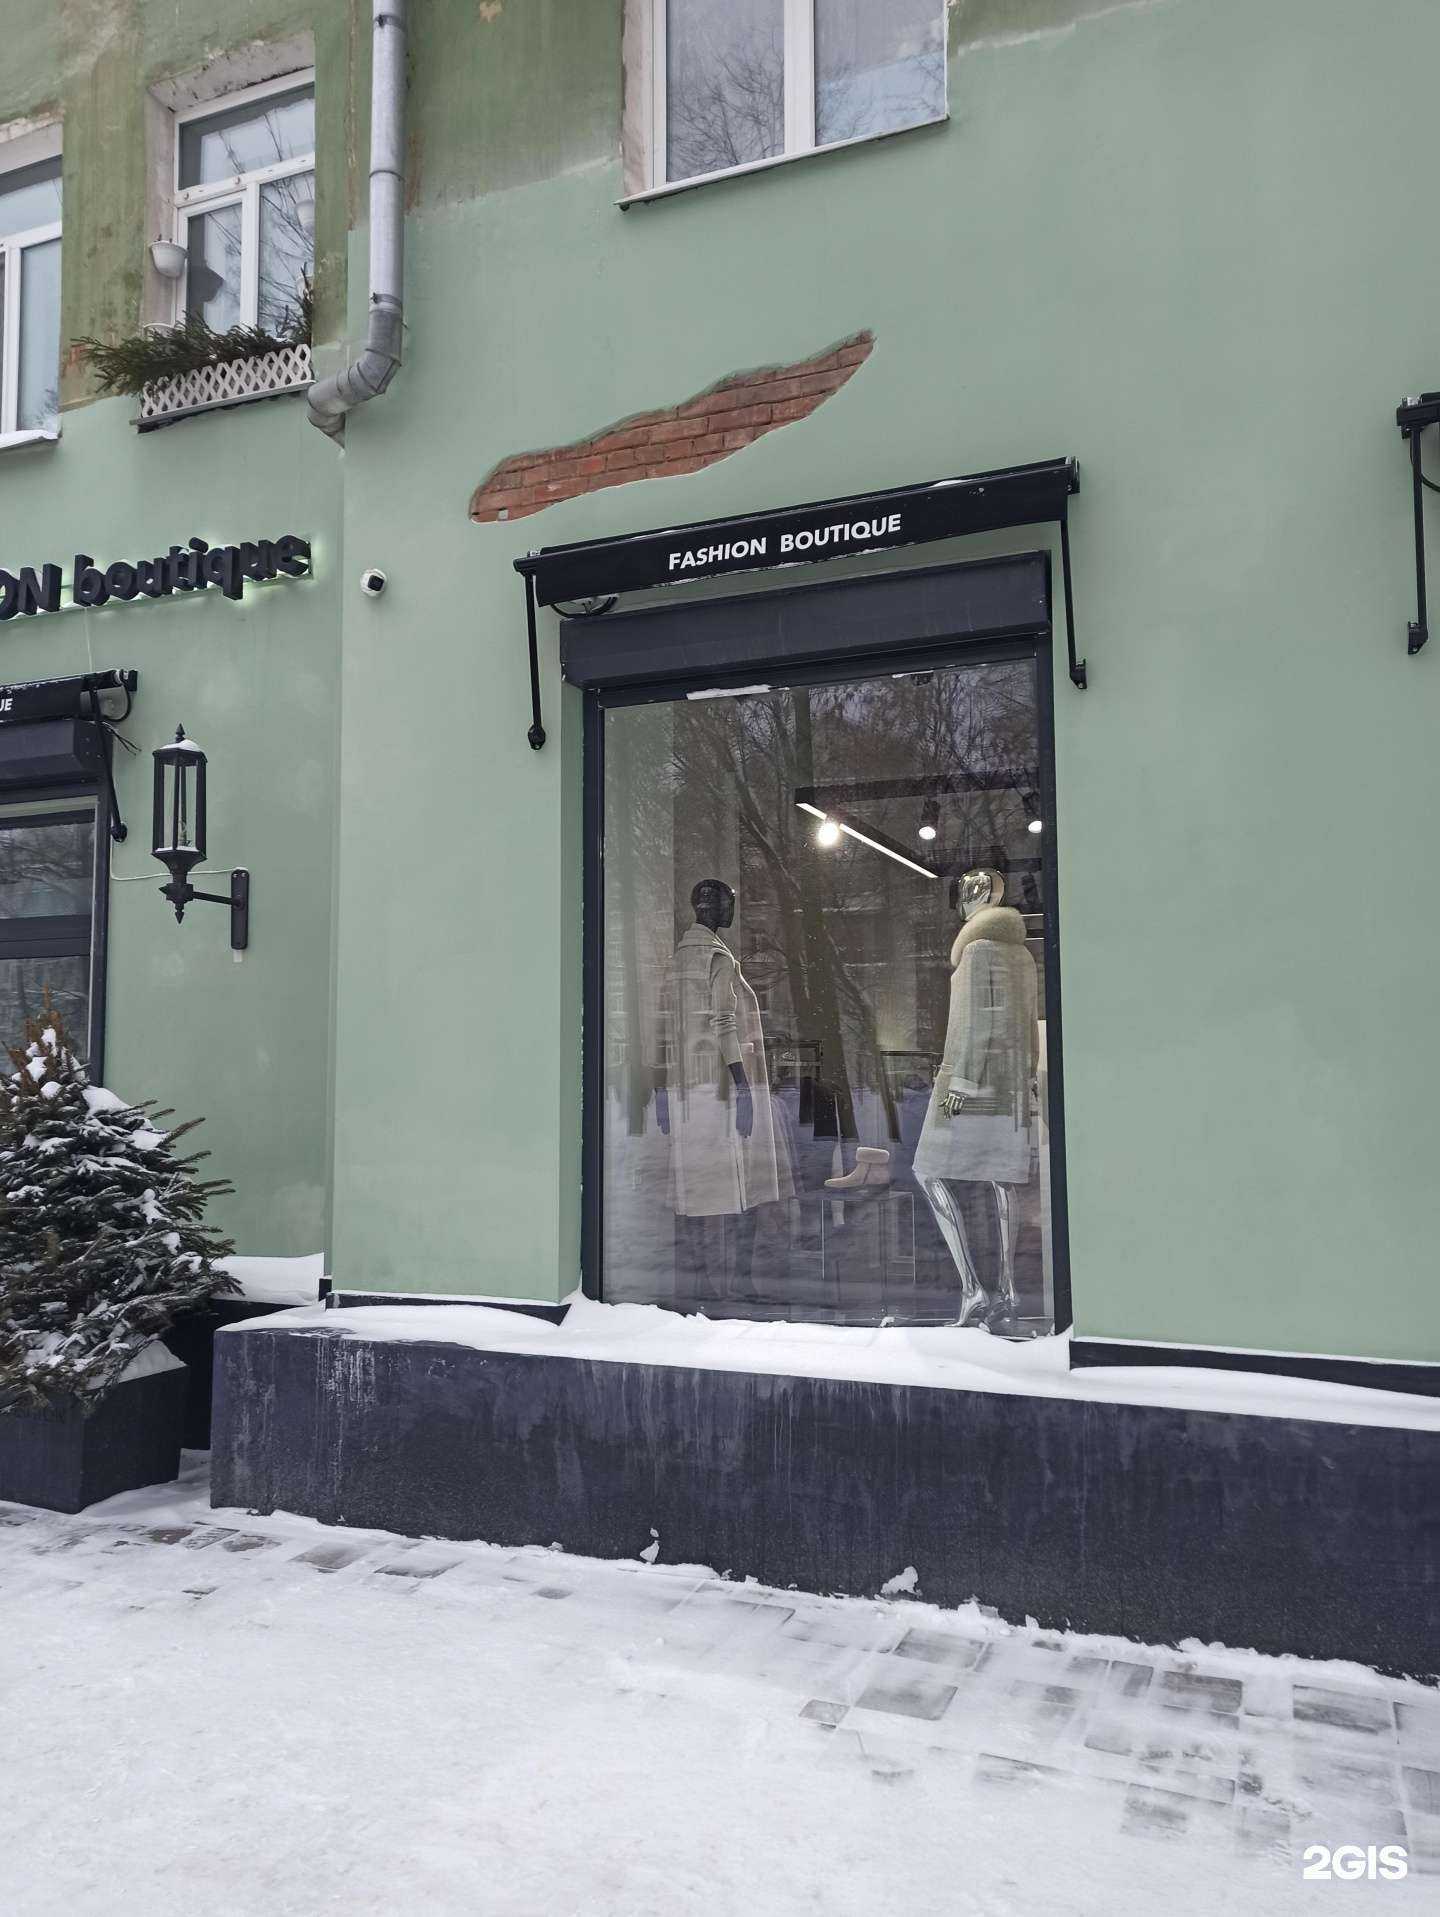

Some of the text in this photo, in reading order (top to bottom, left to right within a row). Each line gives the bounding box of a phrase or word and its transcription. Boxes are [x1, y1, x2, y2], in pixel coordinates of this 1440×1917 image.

[73, 534, 311, 606] boutique
[668, 513, 902, 571] FASHION BOUTIQUE
